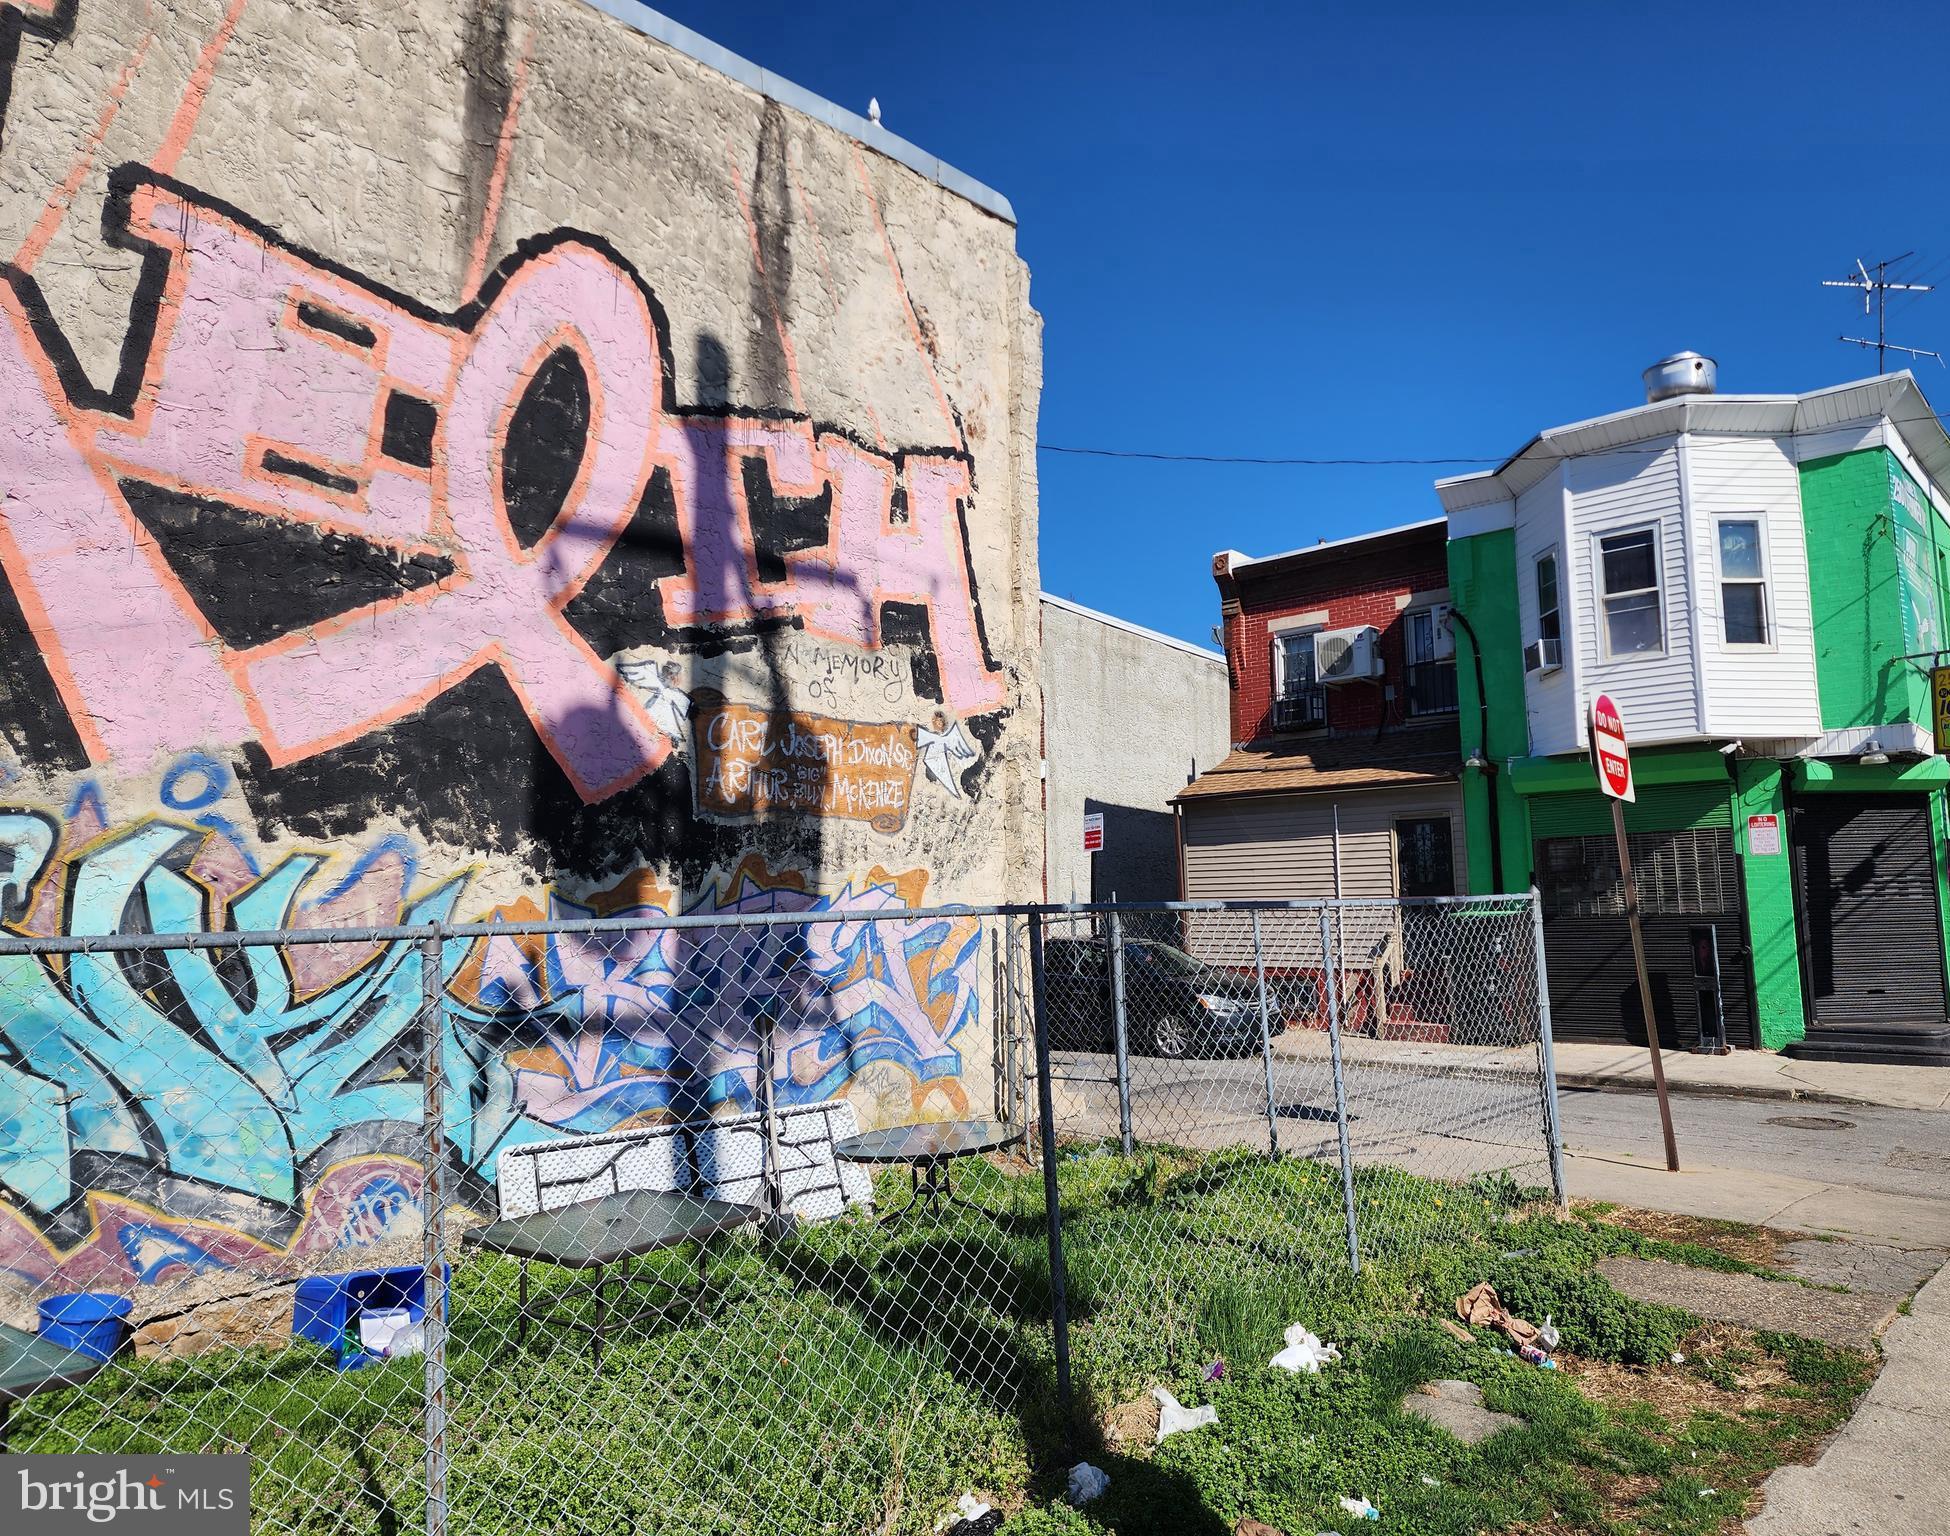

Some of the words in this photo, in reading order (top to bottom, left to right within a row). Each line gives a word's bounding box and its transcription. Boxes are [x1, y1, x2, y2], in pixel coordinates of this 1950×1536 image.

[812, 646, 908, 703] MEMORY
[707, 712, 776, 756] CARL
[1597, 711, 1607, 728] DO
[1607, 716, 1621, 734] NOT
[706, 757, 789, 804] ARTHUR
[1605, 757, 1625, 778] ENTER
